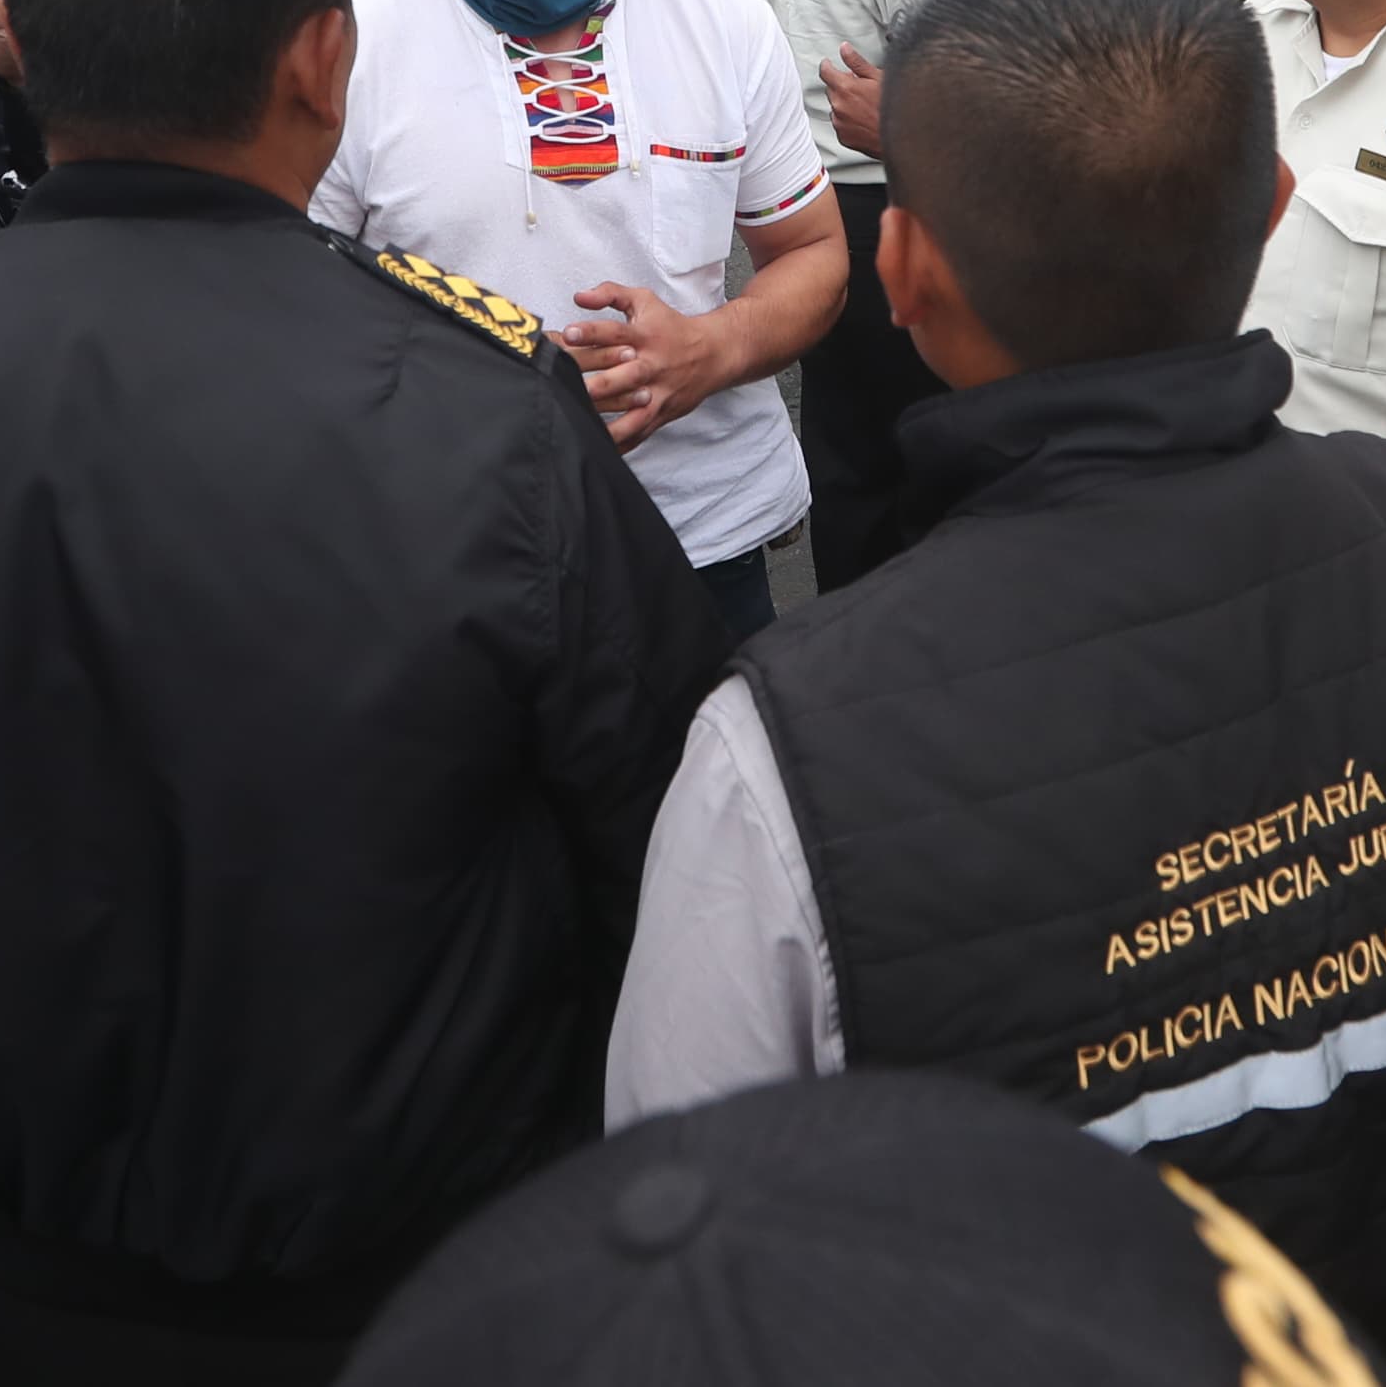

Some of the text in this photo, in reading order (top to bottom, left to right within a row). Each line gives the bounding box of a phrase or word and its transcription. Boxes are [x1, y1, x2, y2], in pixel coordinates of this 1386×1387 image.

[1155, 757, 1386, 893] SECRETARÍA
[1104, 855, 1330, 975] ASISTENCIA
[1075, 993, 1245, 1091] POLICIA
